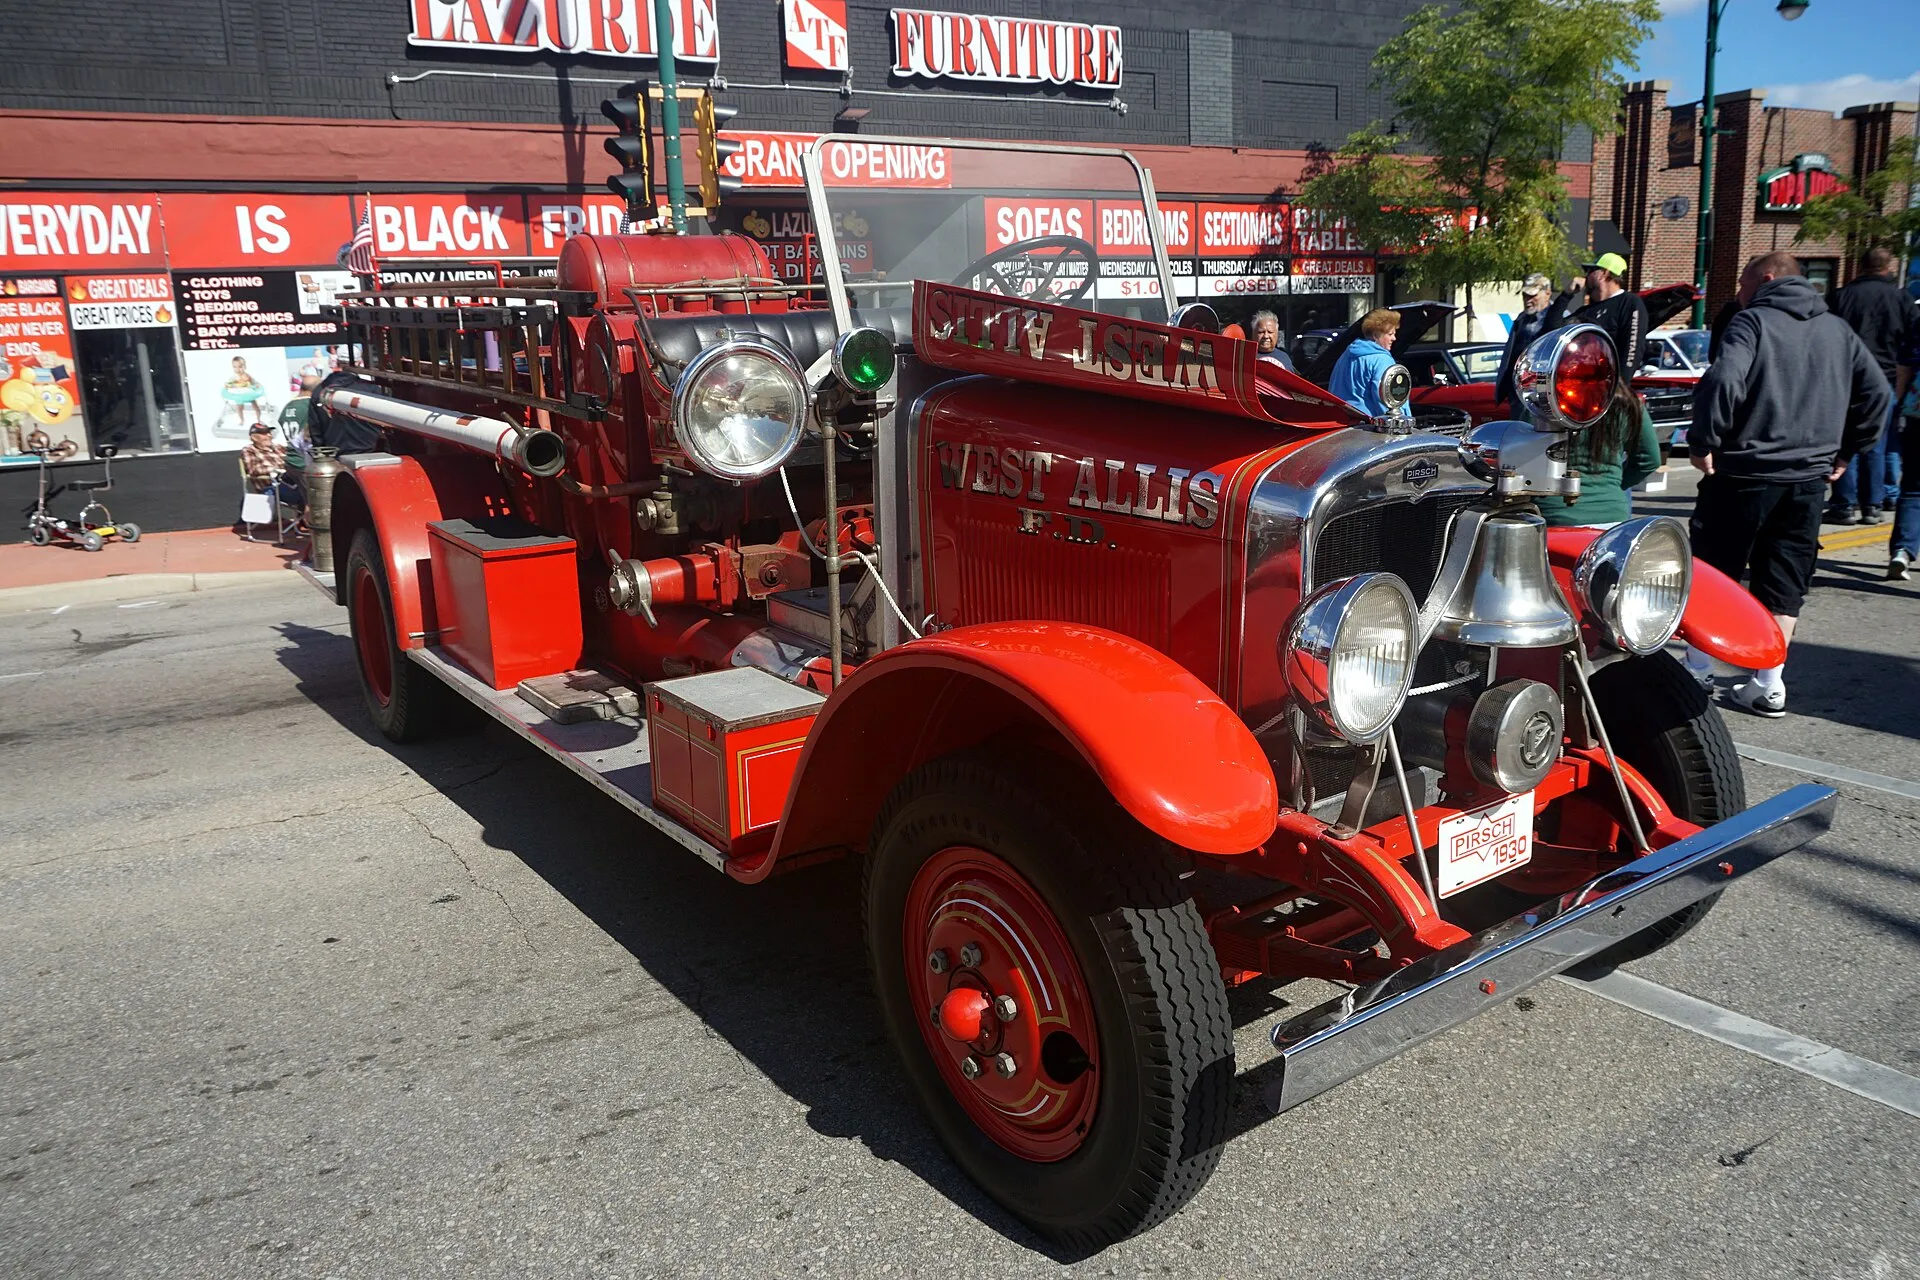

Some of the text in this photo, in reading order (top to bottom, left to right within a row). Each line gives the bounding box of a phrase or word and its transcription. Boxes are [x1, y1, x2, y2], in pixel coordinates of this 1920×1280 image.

[789, 2, 846, 67] ATF
[892, 10, 1120, 85] FURNITURE
[724, 140, 945, 180] GRAN OPENING
[0, 205, 666, 255] ERYDAY IS BLACK FRID
[771, 212, 843, 237] LAZUE
[997, 207, 1083, 245] SOFAS
[1204, 211, 1283, 246] SECTIONALS
[763, 244, 867, 259] OT BARAINS
[786, 263, 850, 278] DAS
[1099, 261, 1146, 276] WEDNESDAY
[1151, 261, 1193, 276] MCOLES
[1202, 261, 1247, 275] THURSDAY
[1252, 261, 1284, 274] JUEVES
[1302, 261, 1364, 274] GREAT DEALS
[88, 278, 168, 299] GREAT DEALS
[190, 276, 264, 288] CLOTHING
[1121, 281, 1159, 296] $1.0
[1214, 279, 1278, 293] CLOSED
[1295, 276, 1371, 291] WHOLESALE PRICES
[192, 289, 232, 300] TOYS
[18, 301, 63, 317] BLACK
[75, 305, 153, 325] GREAT PRICES
[193, 301, 259, 313] BEDDING
[195, 312, 295, 325] ELECTRONICS
[21, 321, 65, 336] NEVER
[197, 322, 337, 337] BABY ACCESSORIES
[5, 341, 41, 357] ENDS
[1072, 317, 1227, 400] WEST
[1407, 467, 1437, 480] PIRSCH
[936, 440, 1225, 529] WEST ALLIS
[1017, 507, 1117, 549] F.D.
[1455, 818, 1512, 857] PIRSCH
[1493, 835, 1527, 866] 1930
